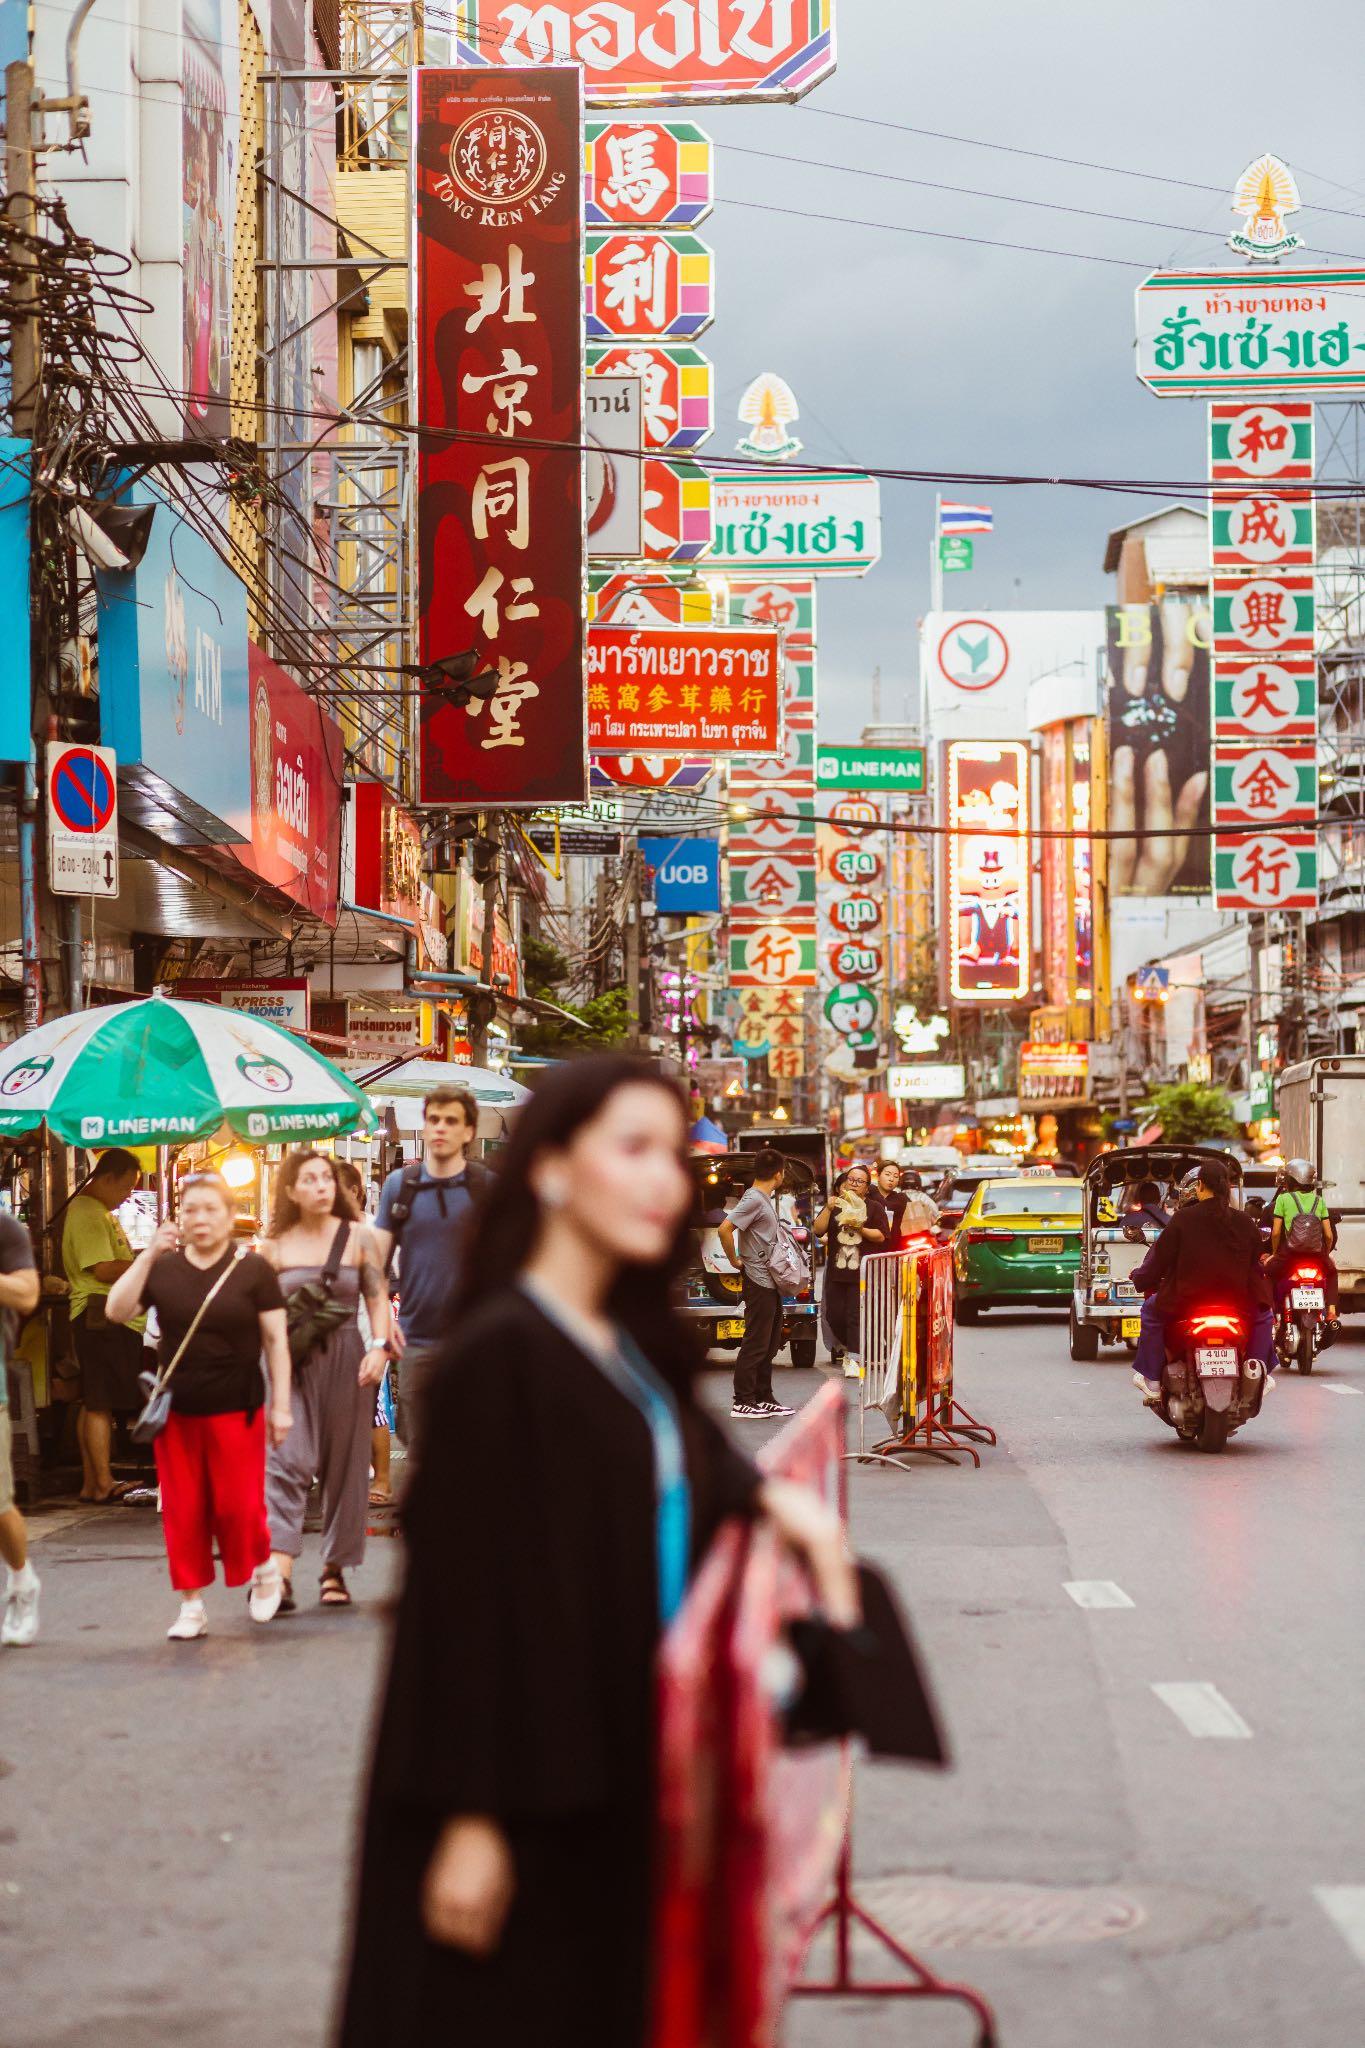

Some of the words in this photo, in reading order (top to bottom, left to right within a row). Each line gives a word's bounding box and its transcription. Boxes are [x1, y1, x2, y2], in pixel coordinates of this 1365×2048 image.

[486, 125, 509, 196] 同仁堂
[432, 173, 475, 219] TONG
[479, 206, 523, 226] REN
[524, 172, 566, 216] TANG
[1153, 305, 1365, 371] ฮั่วเซ่งเฮ
[461, 243, 540, 750] 北京同仁堂
[195, 625, 222, 726] ATM
[588, 633, 770, 678] มาร์ทเยาวราช
[1236, 414, 1291, 897] 和成興大金行
[660, 865, 709, 884] UOB
[231, 996, 284, 1007] XPRESS
[1211, 1367, 1225, 1375] 59
